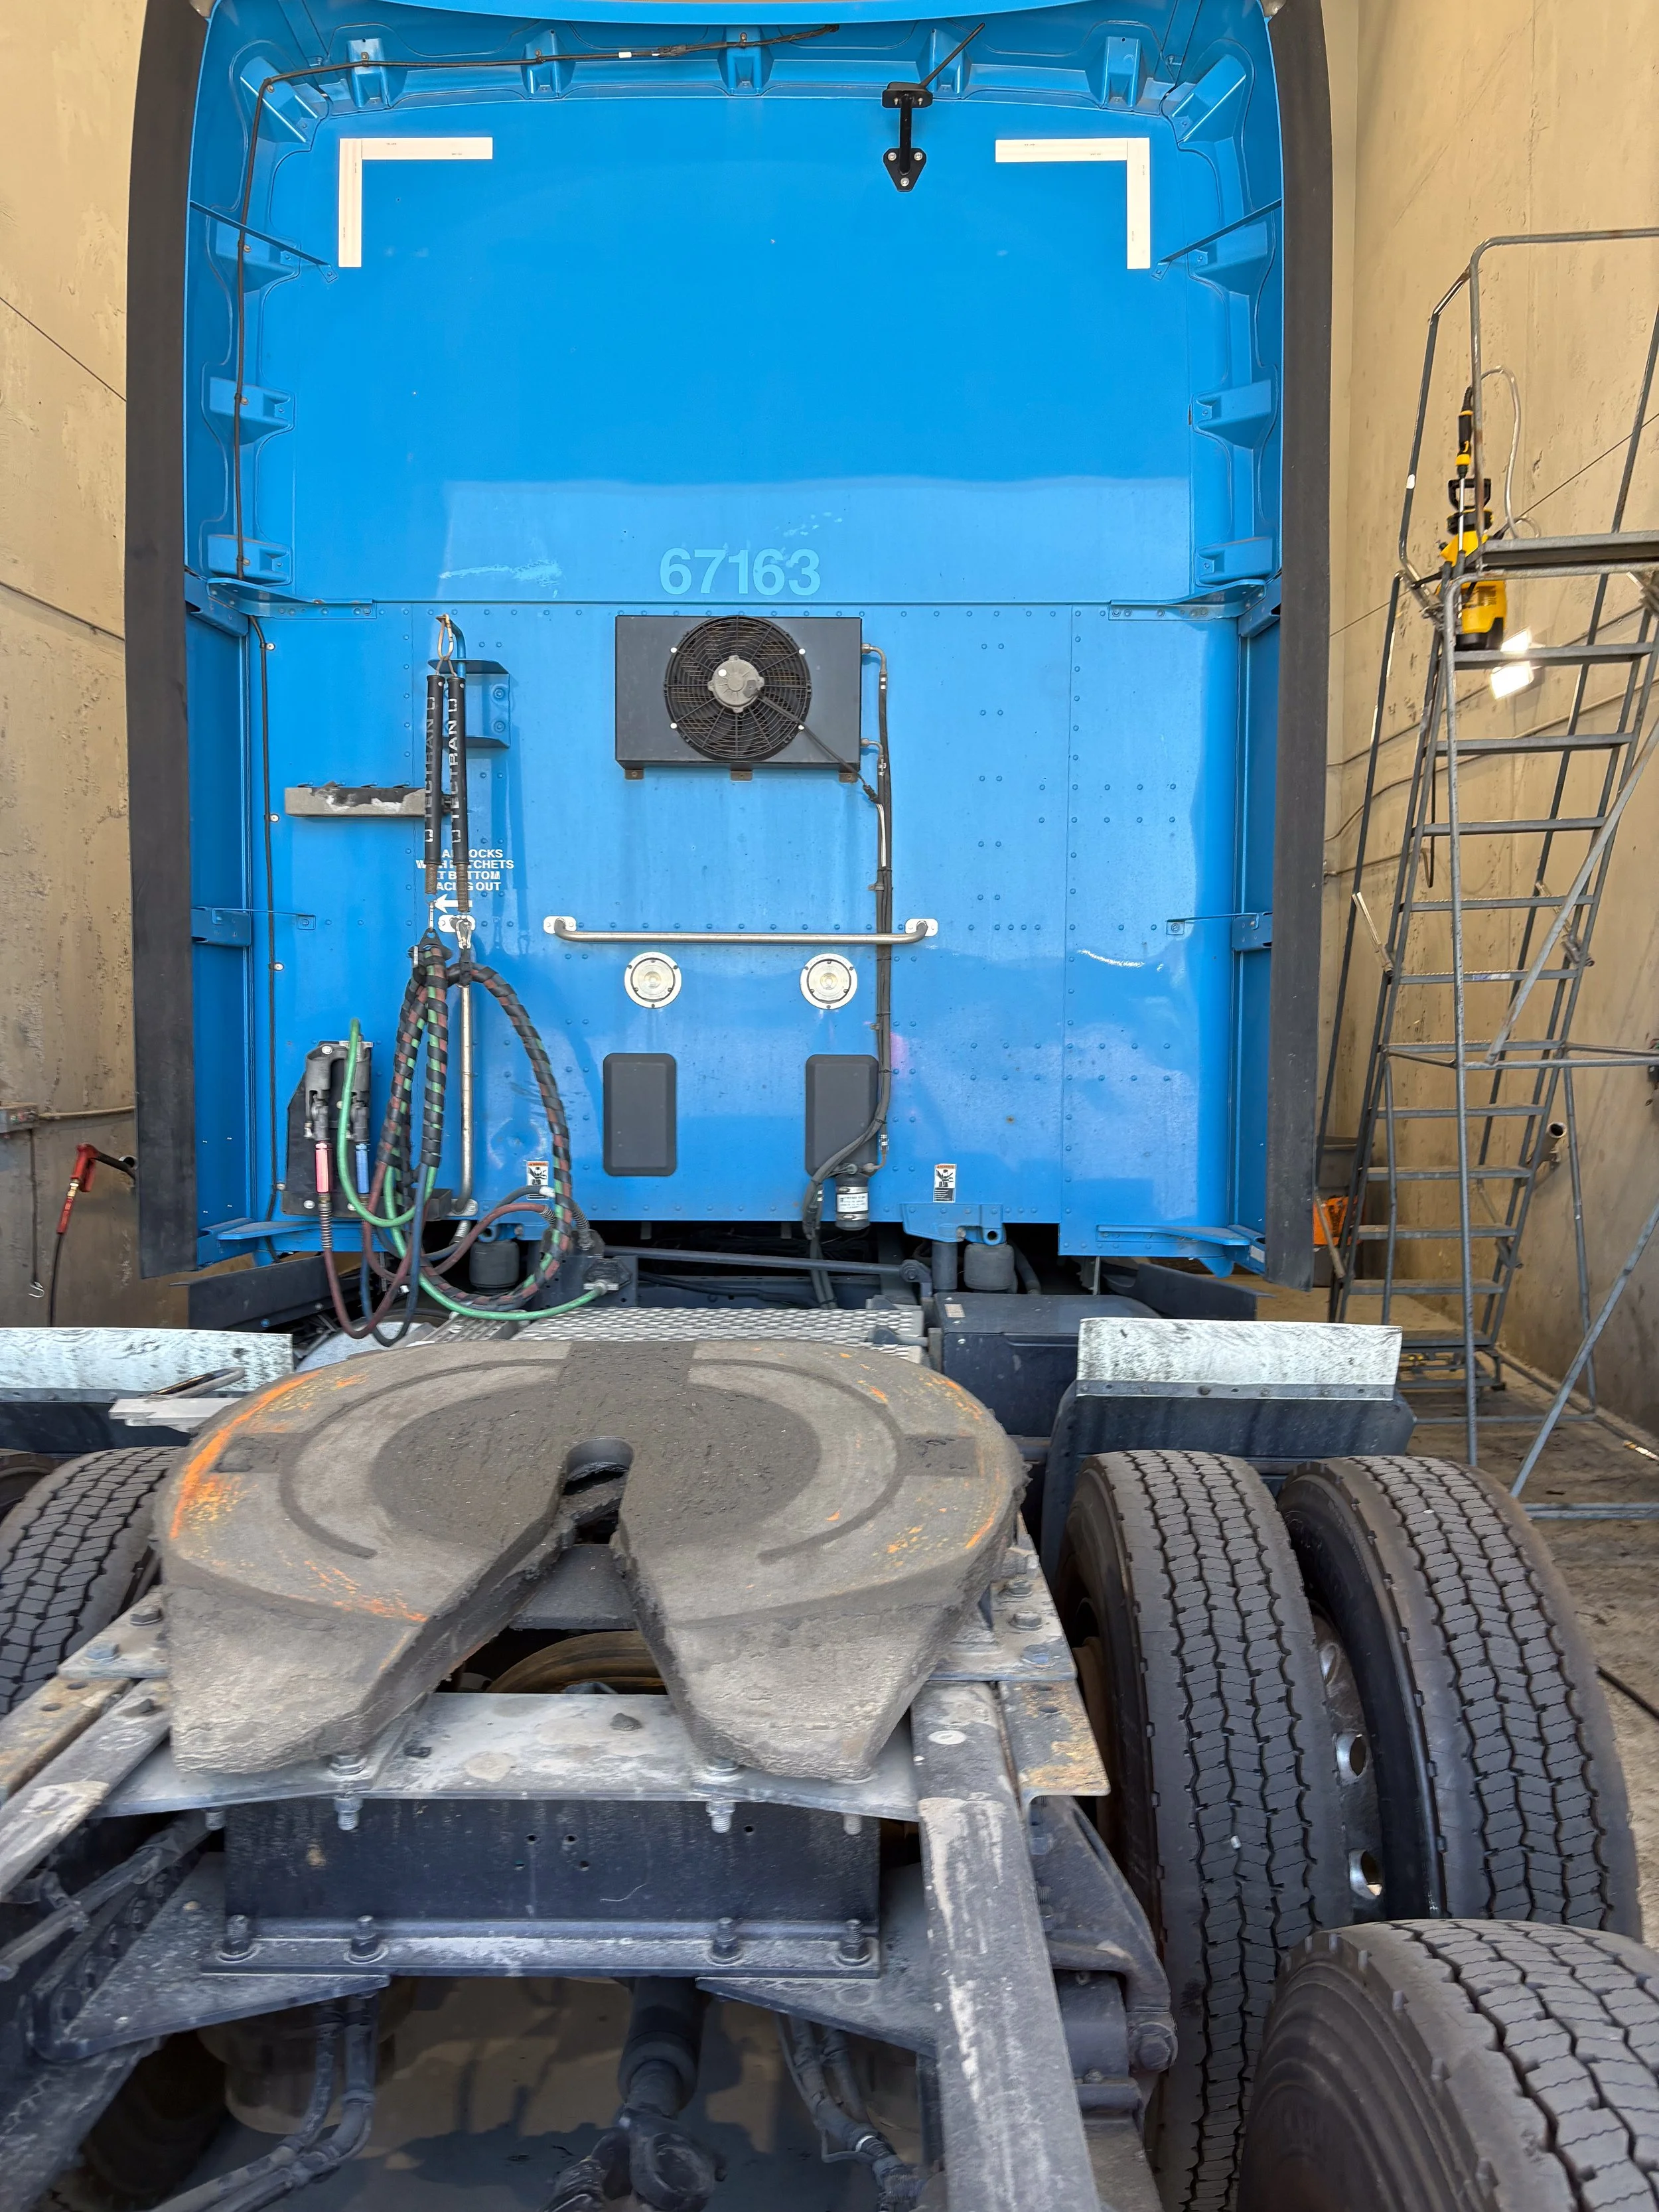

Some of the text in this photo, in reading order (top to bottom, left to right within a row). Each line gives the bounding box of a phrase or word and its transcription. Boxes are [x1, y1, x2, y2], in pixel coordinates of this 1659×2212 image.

[660, 548, 820, 595] 67163
[468, 849, 503, 858] OCKS
[415, 859, 448, 869] WH
[448, 871, 500, 880] BTTOM
[475, 881, 502, 891] OUT
